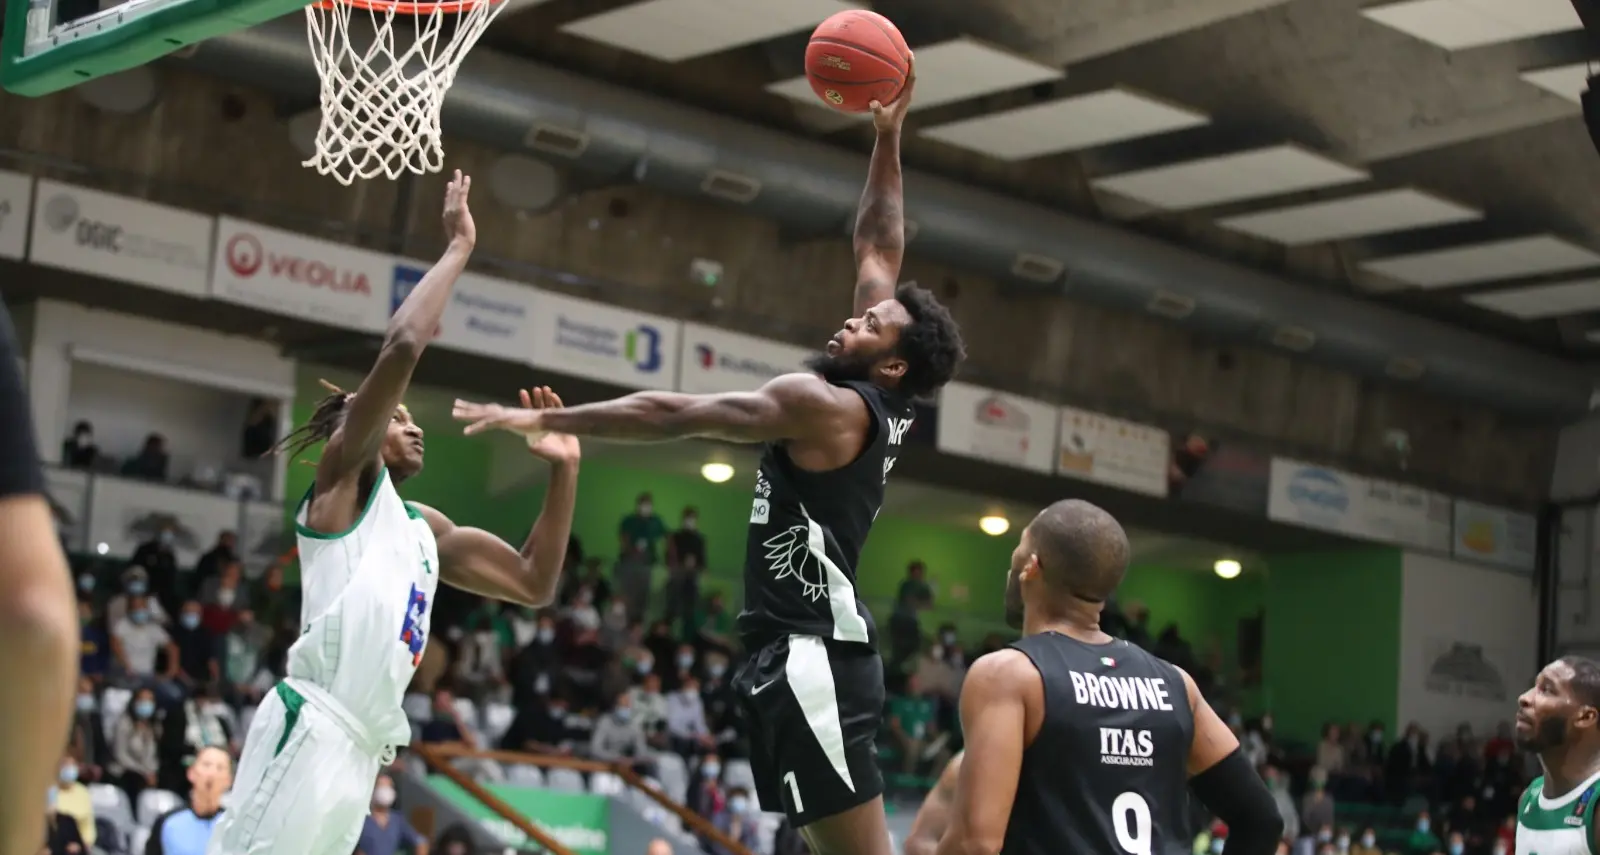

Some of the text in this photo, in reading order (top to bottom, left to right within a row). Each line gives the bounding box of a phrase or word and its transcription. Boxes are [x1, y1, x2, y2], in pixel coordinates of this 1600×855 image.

[268, 254, 372, 297] VEOLIA
[1069, 670, 1173, 711] BROWNE
[1100, 727, 1154, 757] ITAS
[1101, 755, 1153, 766] ASSICURAZIONI
[783, 771, 804, 813] 1
[1112, 791, 1152, 855] 9
